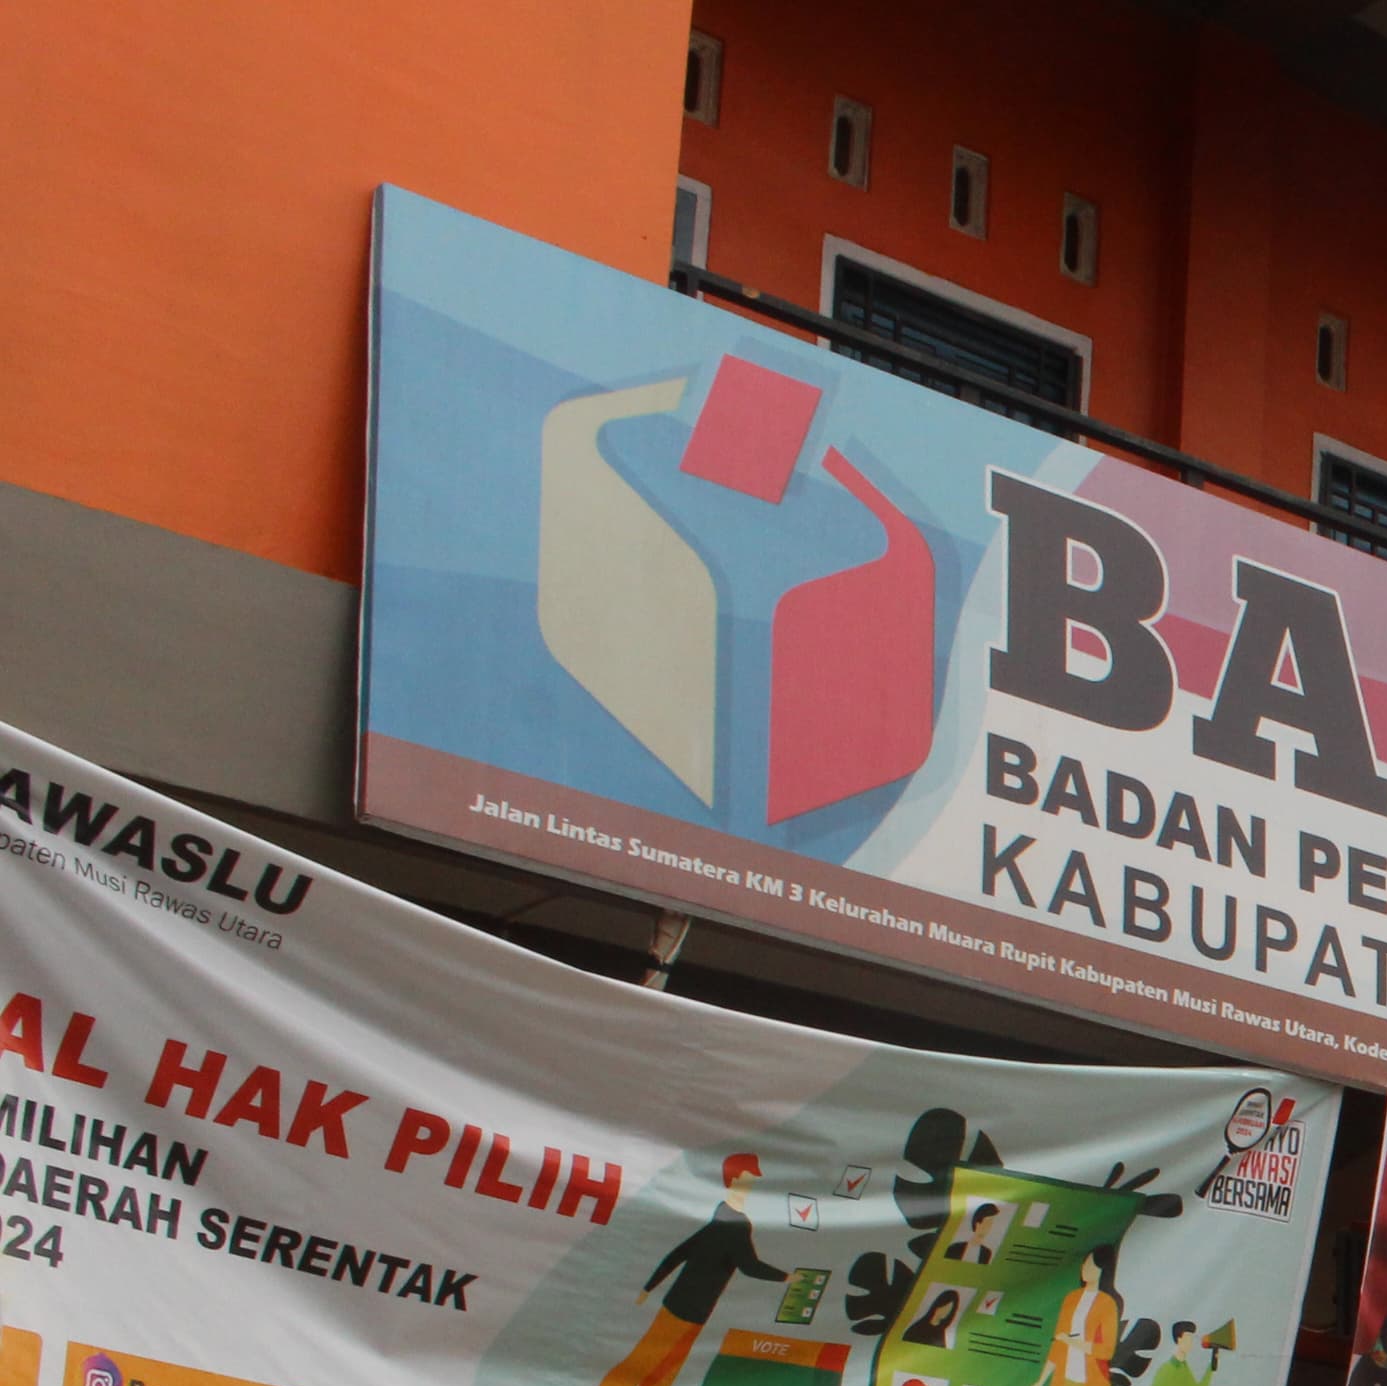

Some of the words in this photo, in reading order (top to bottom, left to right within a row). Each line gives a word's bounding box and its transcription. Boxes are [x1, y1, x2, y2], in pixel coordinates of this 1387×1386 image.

[986, 732, 1267, 879] BADAN
[74, 856, 127, 895] Musi
[134, 879, 212, 926] Rawas
[218, 910, 283, 950] Utara
[469, 793, 541, 830] Jalan
[546, 812, 623, 853] Lintas
[627, 837, 741, 886] Sumatera
[746, 870, 784, 900] KM
[789, 883, 804, 902] 3
[808, 889, 925, 938] Kelurahan
[929, 921, 996, 957] Muara
[1001, 941, 1056, 974] Rupit
[1060, 958, 1169, 1004] Kabupaten
[1173, 986, 1217, 1018] Musi
[1221, 999, 1281, 1033] Rawas
[1284, 1016, 1340, 1052] Utara,
[144, 1038, 368, 1159] HAK
[384, 1107, 624, 1227] PILIH
[1236, 1150, 1298, 1187] AWASI
[0, 1153, 183, 1240] AERAH
[196, 1207, 479, 1312] SERENTAK
[1210, 1174, 1292, 1217] BERSAMA
[752, 1339, 791, 1356] VOTE
